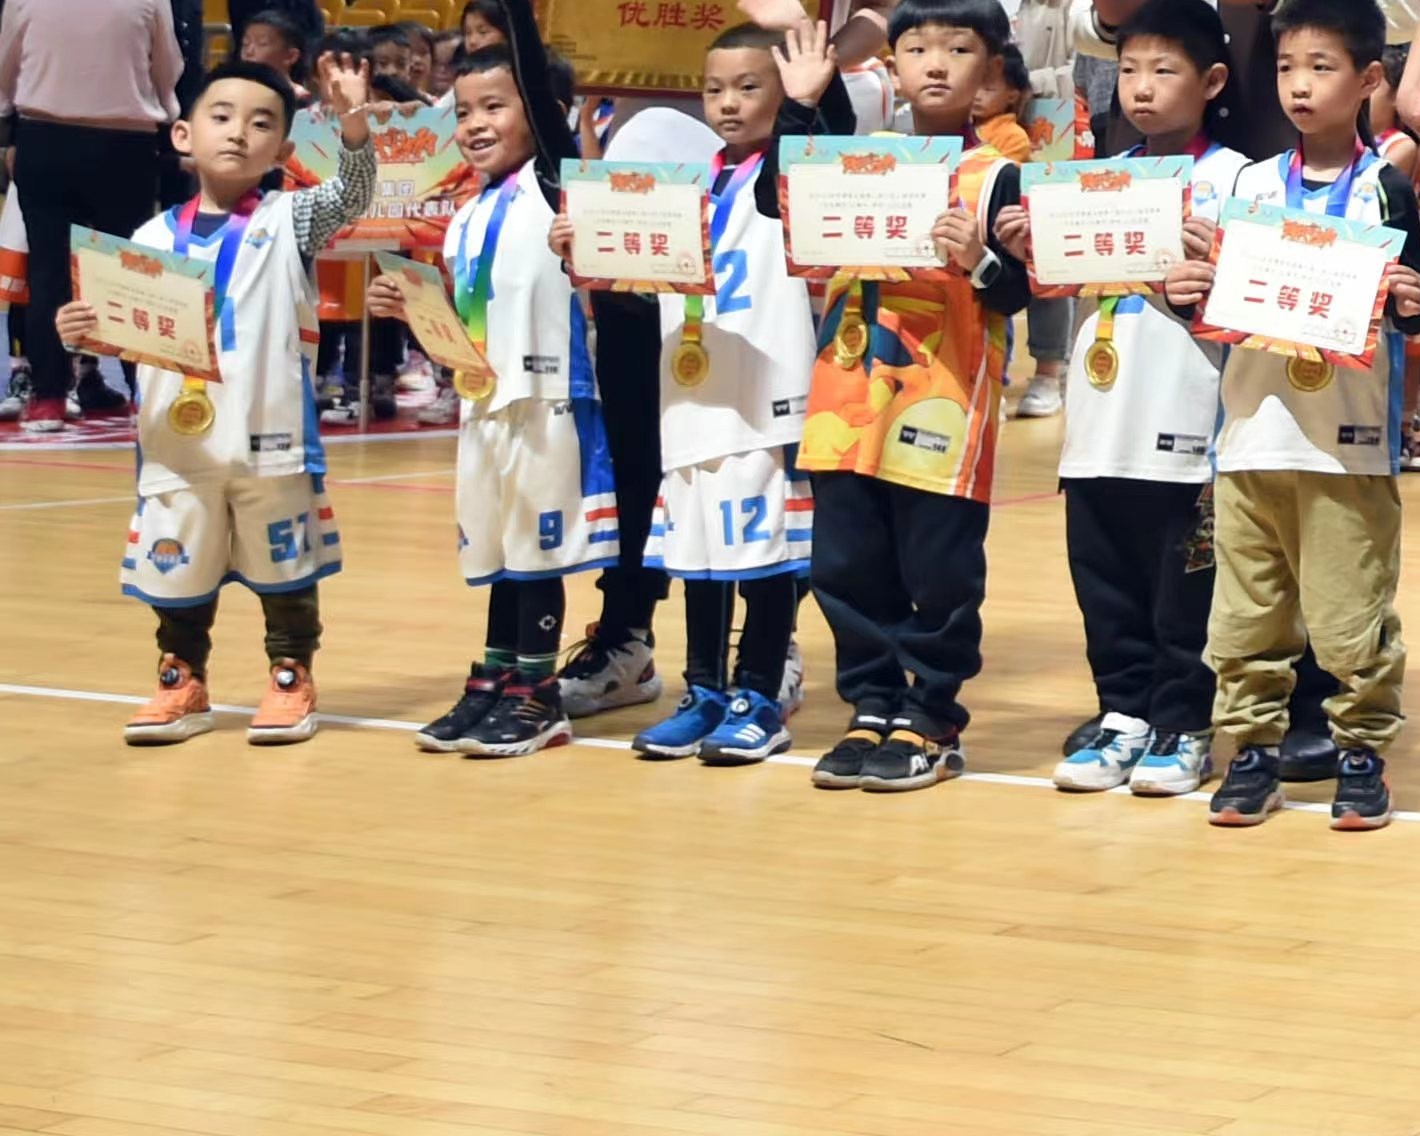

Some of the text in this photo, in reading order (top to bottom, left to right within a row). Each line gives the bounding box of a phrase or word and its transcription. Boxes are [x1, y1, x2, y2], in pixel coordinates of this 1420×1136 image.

[616, 1, 727, 31] 优胜奖
[597, 231, 670, 257] 二等奖
[822, 215, 908, 240] 二等奖
[1064, 231, 1147, 257] 二等奖
[1243, 279, 1334, 319] 二等奖
[106, 300, 177, 340] 二等奖
[538, 510, 563, 551] 9
[718, 496, 768, 546] 12
